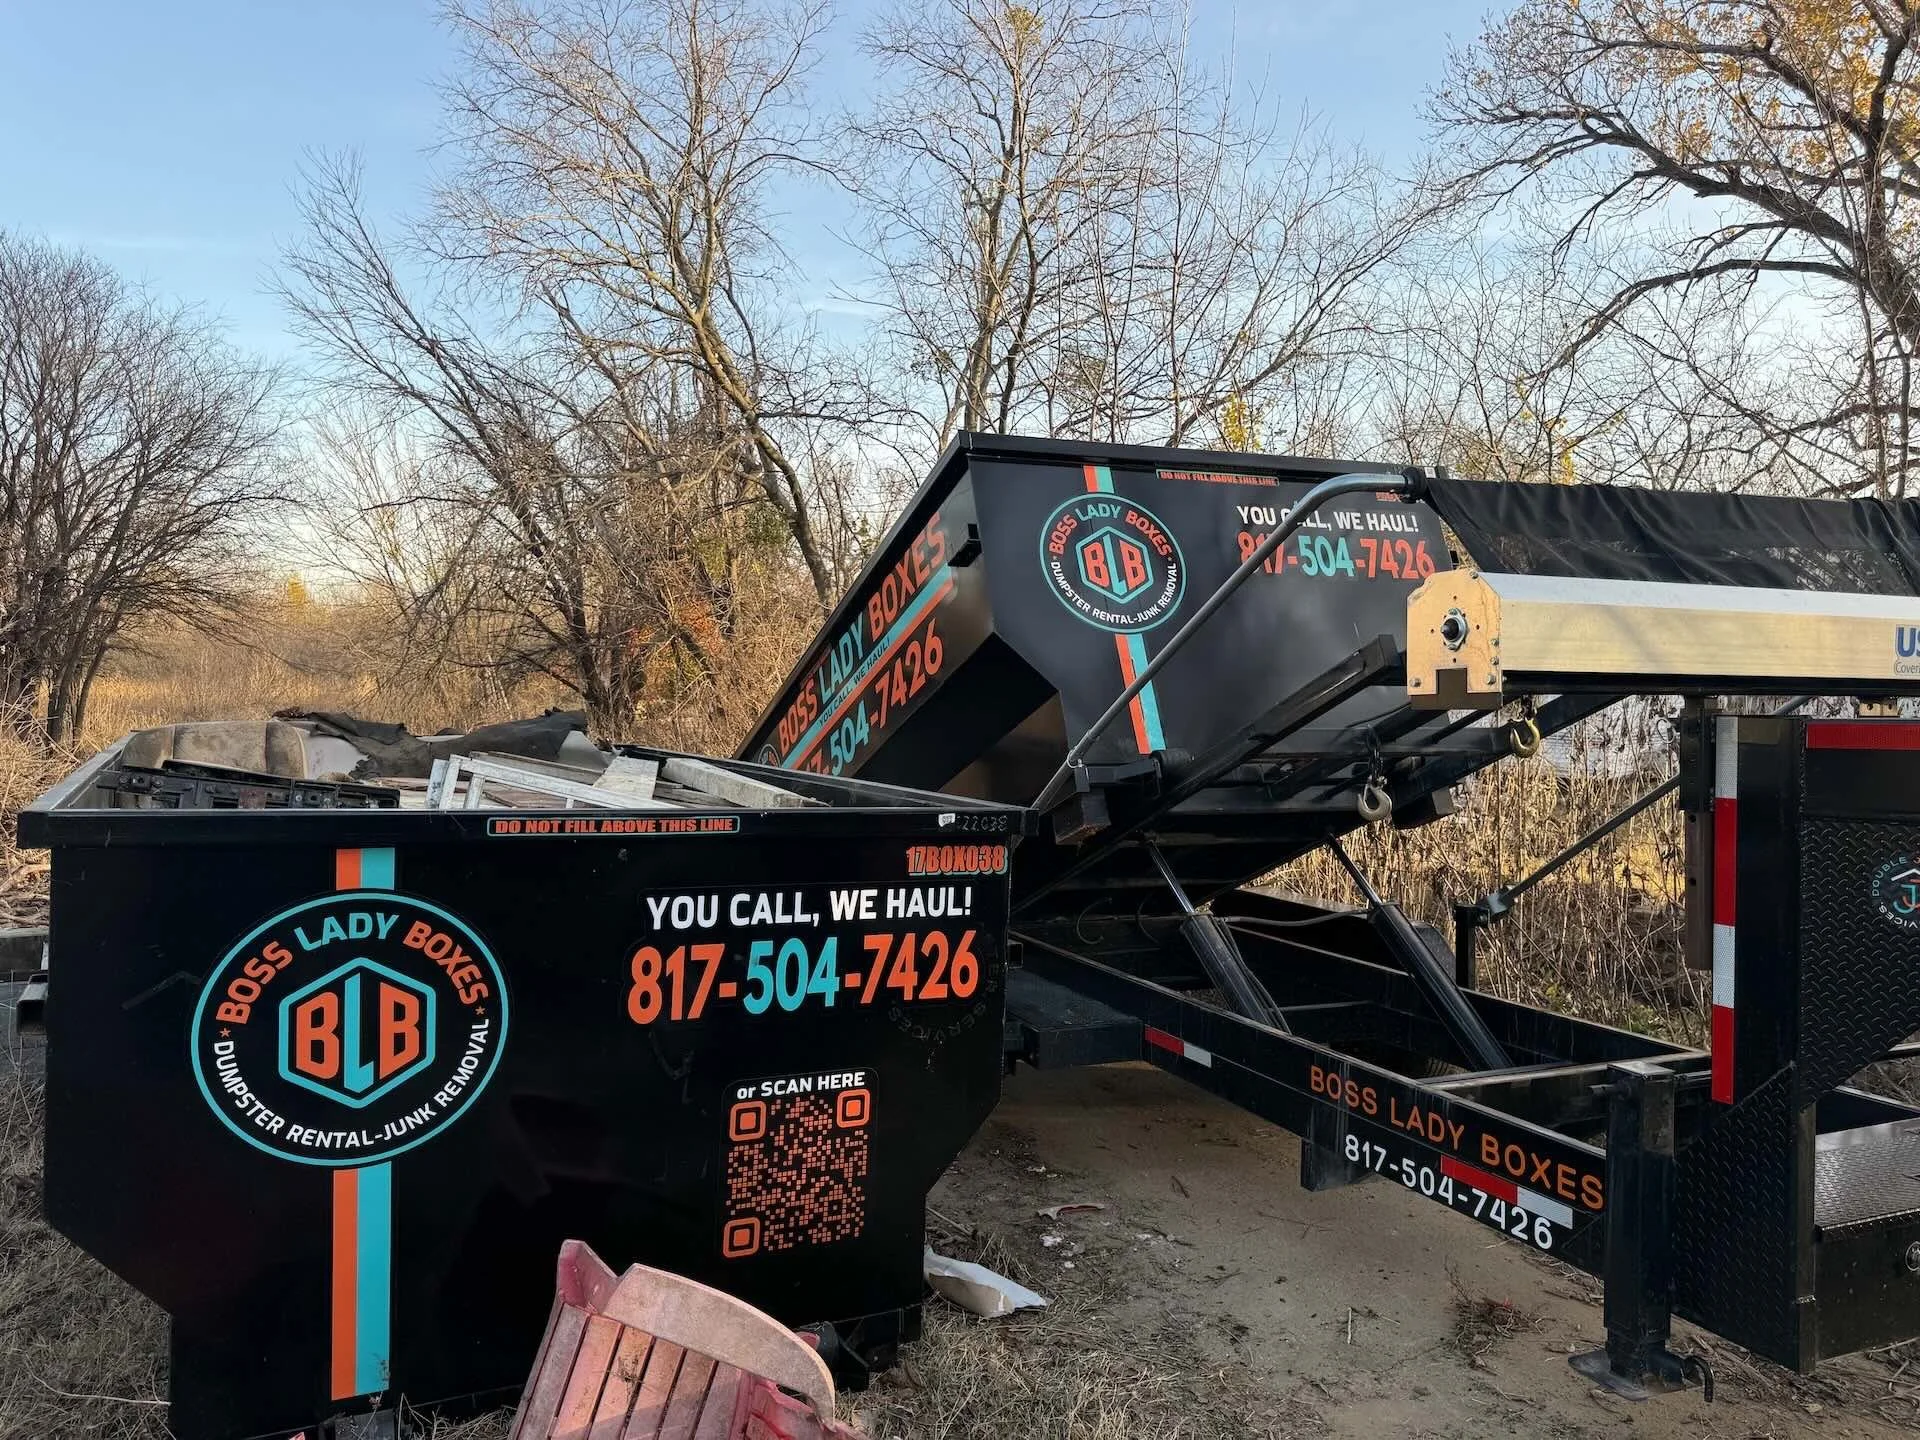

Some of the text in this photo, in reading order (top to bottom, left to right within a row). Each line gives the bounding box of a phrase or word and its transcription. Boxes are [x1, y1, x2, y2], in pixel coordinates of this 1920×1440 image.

[1049, 503, 1172, 556] BOSS LADY BOXES
[1236, 505, 1419, 533] YOU CLL, WE HAUL!
[1051, 561, 1177, 625] DUMPSTER RENTAL-JUNK REMOVAL
[1083, 533, 1146, 595] BLB
[779, 679, 818, 757] BOSS
[819, 612, 863, 704] LADY
[868, 512, 945, 642] BOXES
[1896, 626, 1920, 658] U
[495, 818, 733, 834] DO NOT FILL ABOVE THIS LINE
[906, 845, 1008, 876] 17BOX038
[1872, 856, 1907, 896] DOUBLE
[646, 886, 972, 931] YOU CALL, WE HAUL!
[216, 912, 489, 1024] BOSS LADY BOXES
[627, 929, 979, 1025] 817-504-7426
[296, 972, 420, 1094] BLB
[213, 1018, 490, 1150] DUMPSTER RENTAL-JUNK REMOVAL
[736, 1071, 865, 1100] or SCAN HERE
[1310, 1064, 1606, 1210] BOSS LADY BOXES
[1344, 1134, 1554, 1250] 817-504-7426
